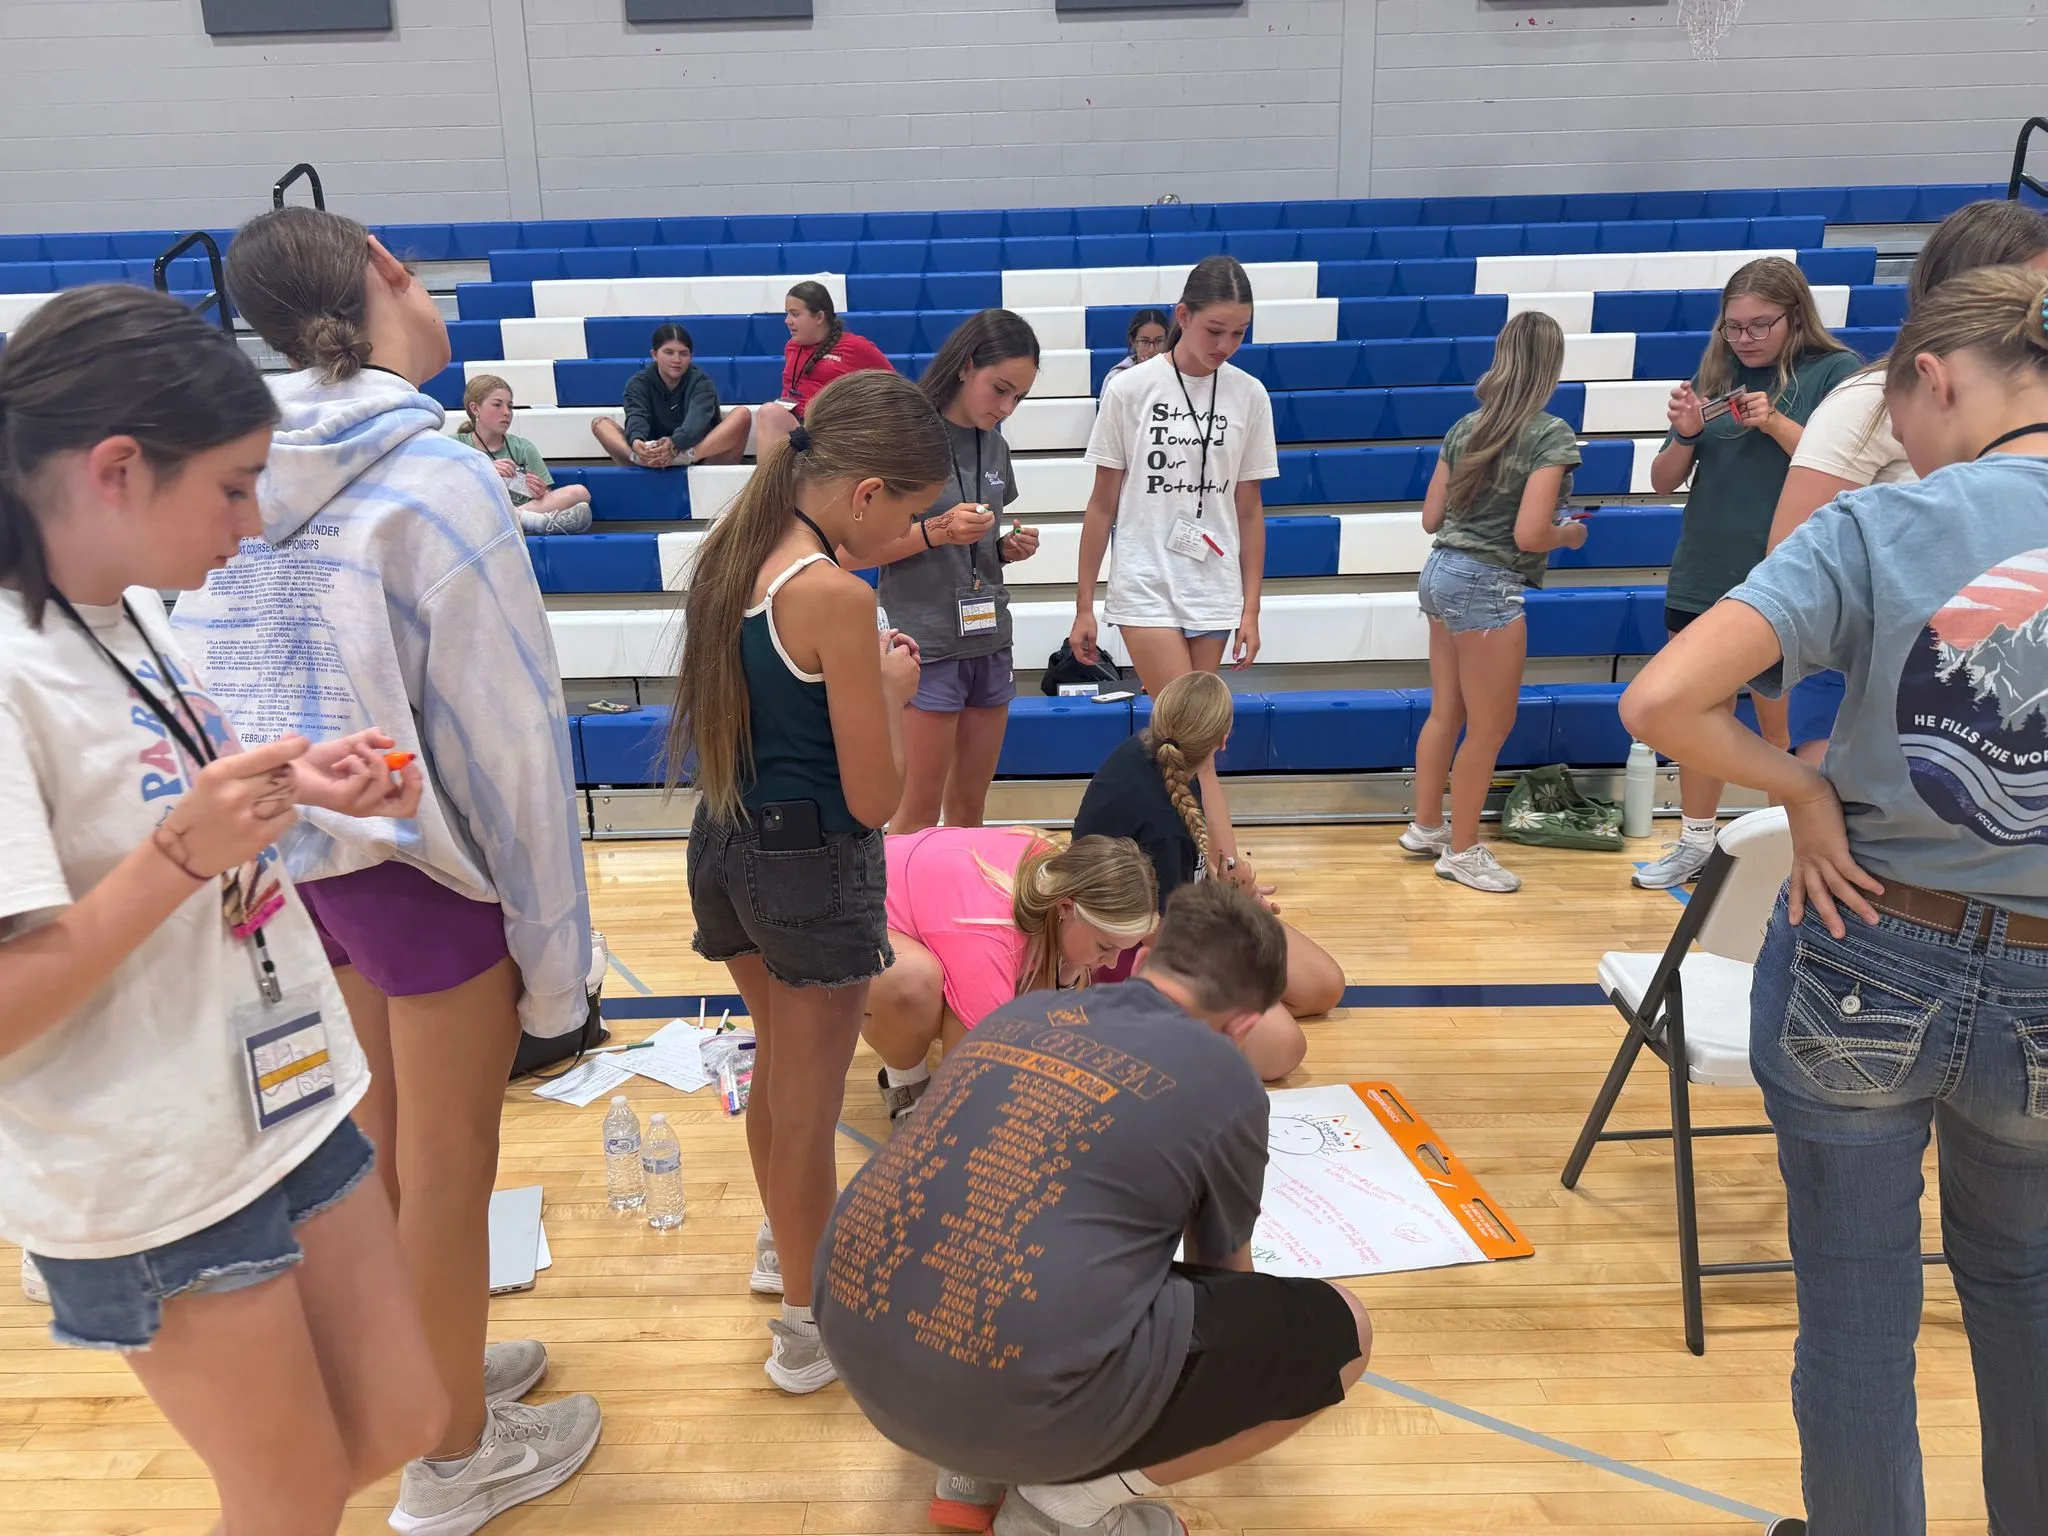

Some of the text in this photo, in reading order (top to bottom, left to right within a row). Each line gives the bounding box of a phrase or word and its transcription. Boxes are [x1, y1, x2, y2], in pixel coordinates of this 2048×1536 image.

[1152, 403, 1228, 430] Strving
[1147, 450, 1186, 470] Our
[1146, 475, 1229, 494] Potential
[310, 524, 340, 537] UNDER
[247, 543, 270, 555] COURSE
[128, 659, 184, 802] PARY
[1914, 713, 1936, 728] HE
[1940, 717, 1981, 745] FILLS
[1980, 739, 2011, 763] THE
[906, 1309, 1024, 1359] OKLAHOMA CITY, OK
[915, 1329, 947, 1352] LITTLE
[949, 1344, 980, 1367] ROCK,
